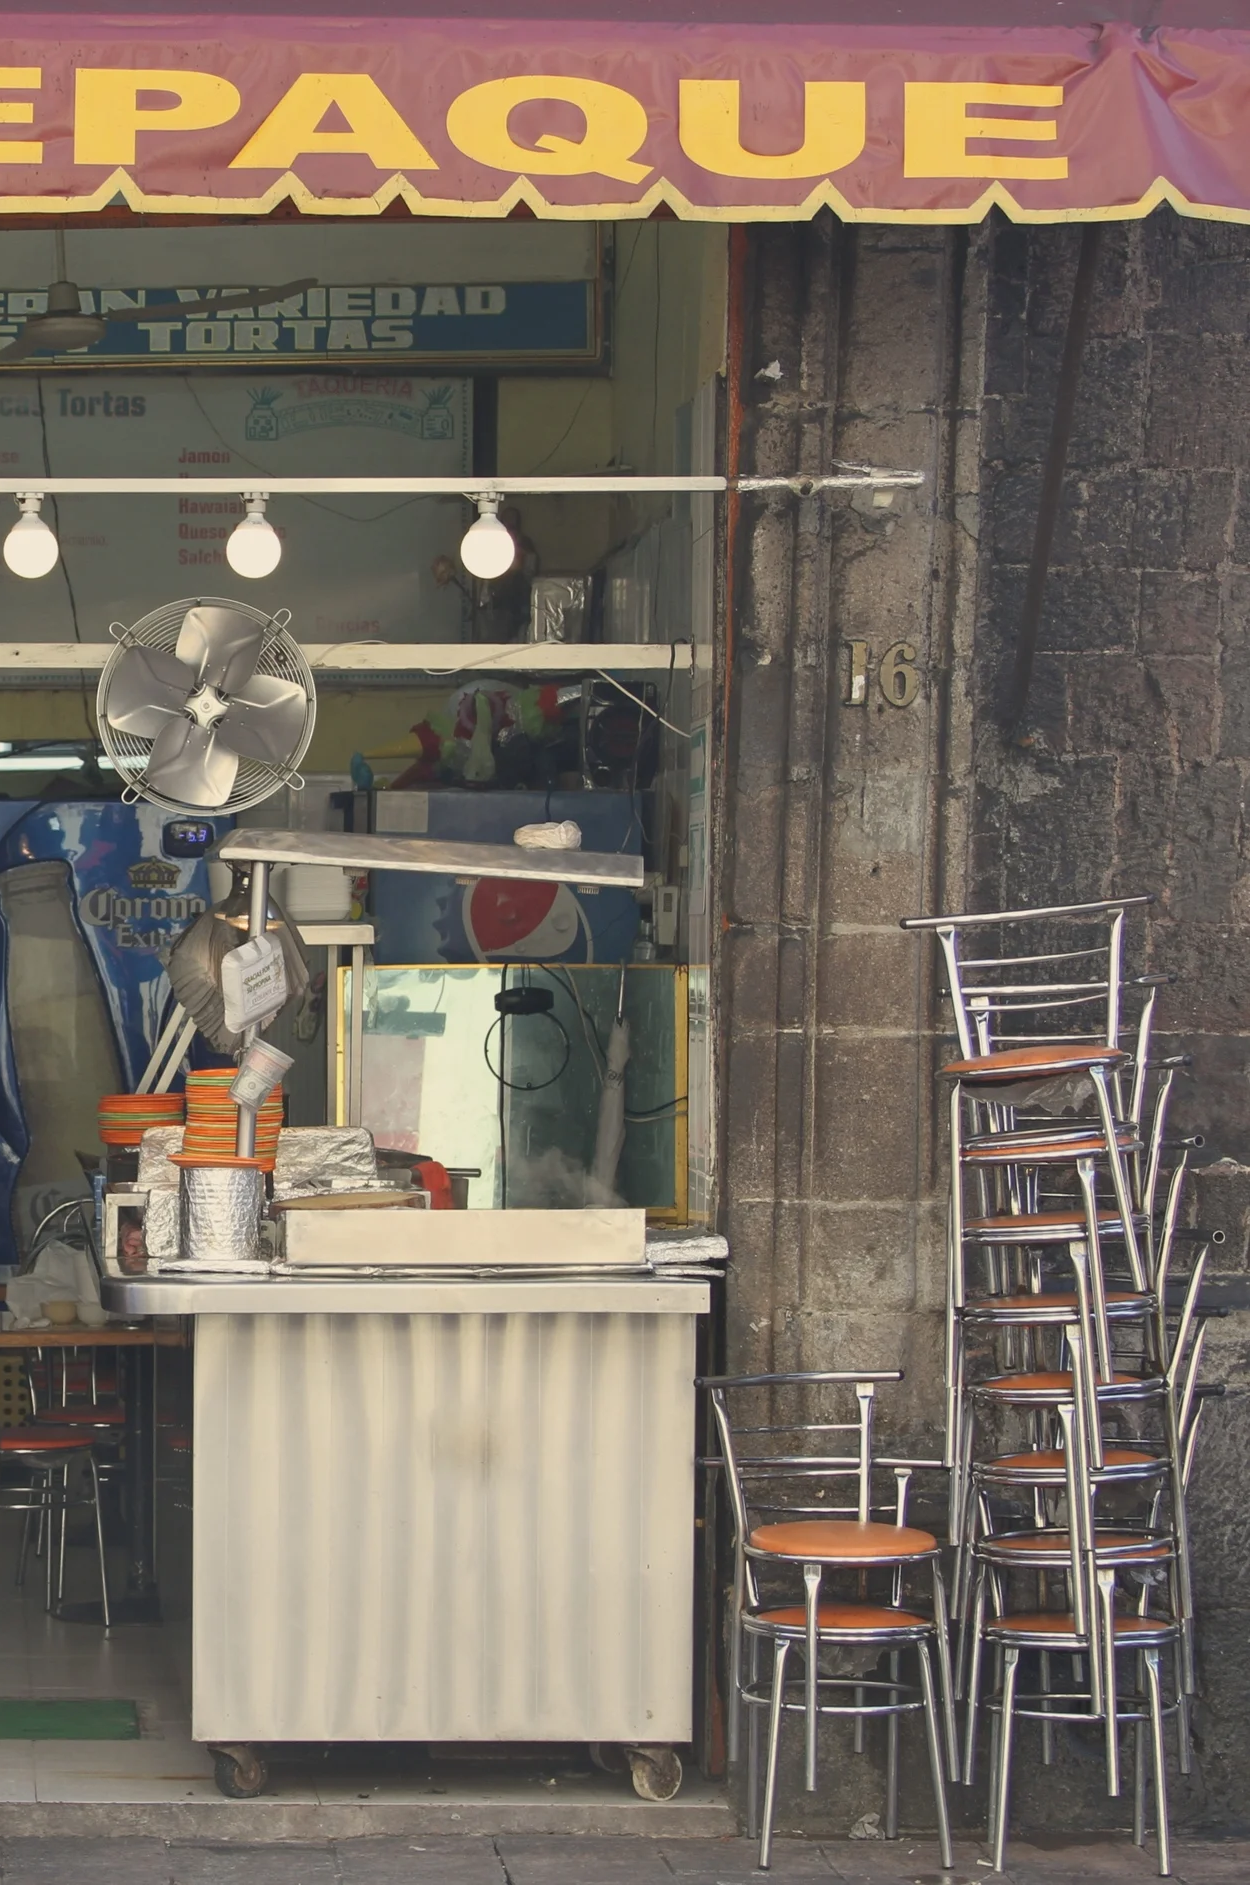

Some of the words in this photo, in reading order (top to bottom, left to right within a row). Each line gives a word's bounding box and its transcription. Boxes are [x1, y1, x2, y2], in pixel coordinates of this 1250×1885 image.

[137, 319, 414, 351] TORTAS
[56, 388, 147, 418] Tortas
[178, 523, 227, 541] Queso
[843, 640, 919, 708] 16
